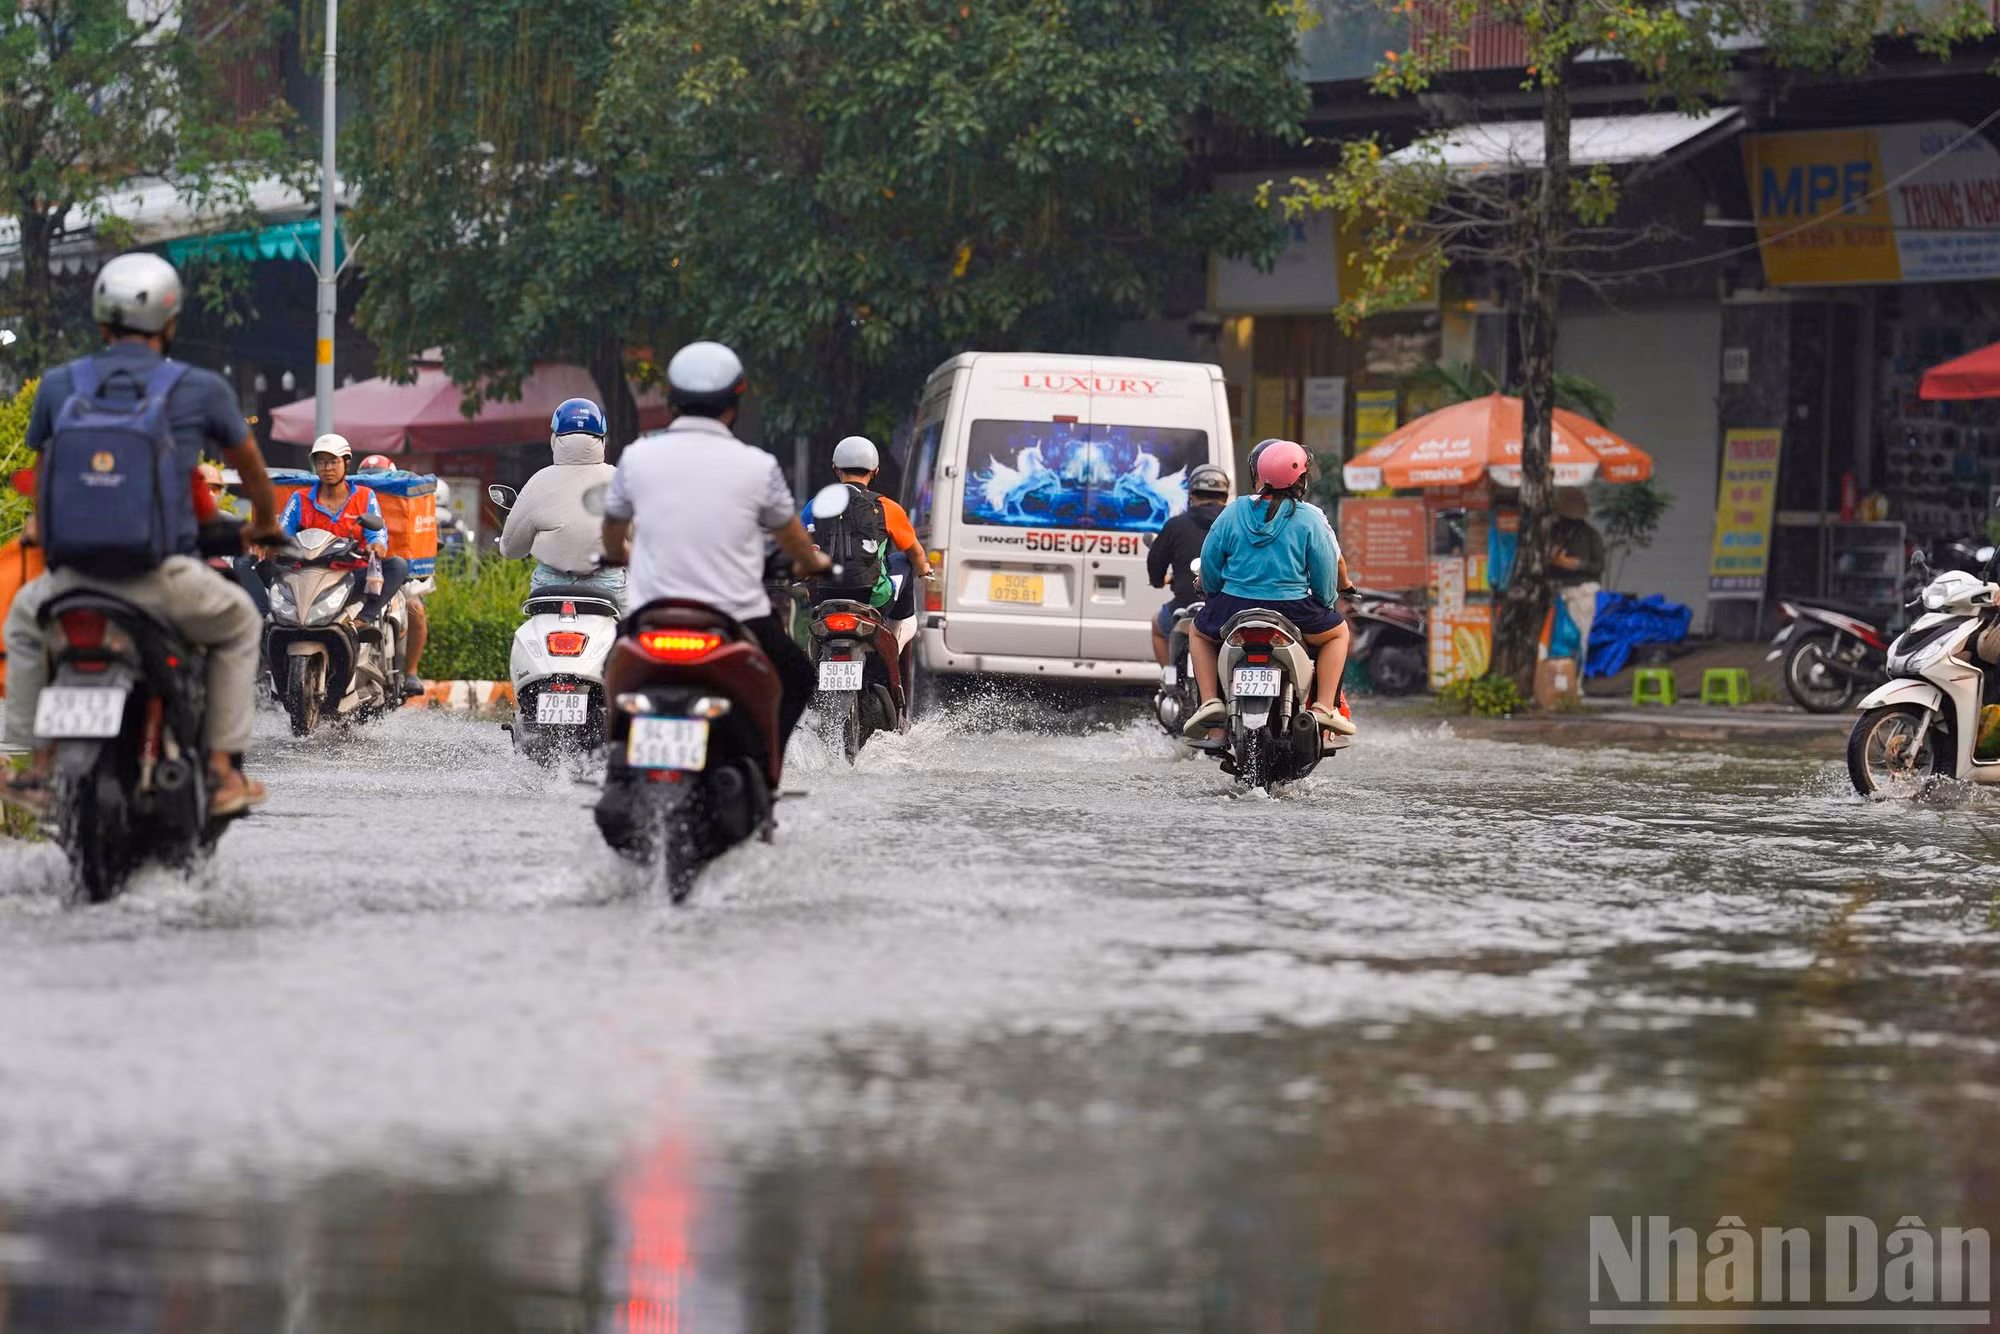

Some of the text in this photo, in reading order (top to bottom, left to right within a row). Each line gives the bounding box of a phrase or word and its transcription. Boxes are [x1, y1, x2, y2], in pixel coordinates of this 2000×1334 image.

[1023, 374, 1161, 393] LUXURY
[978, 535, 1024, 545] TRANSIT
[1005, 576, 1029, 587] 50E
[826, 664, 856, 676] 50-AC
[1241, 670, 1273, 682] 63-B6
[823, 676, 858, 689] 386.84
[1236, 683, 1276, 695] 527.71
[545, 695, 580, 708] 70-AB
[540, 709, 583, 723] 371.33
